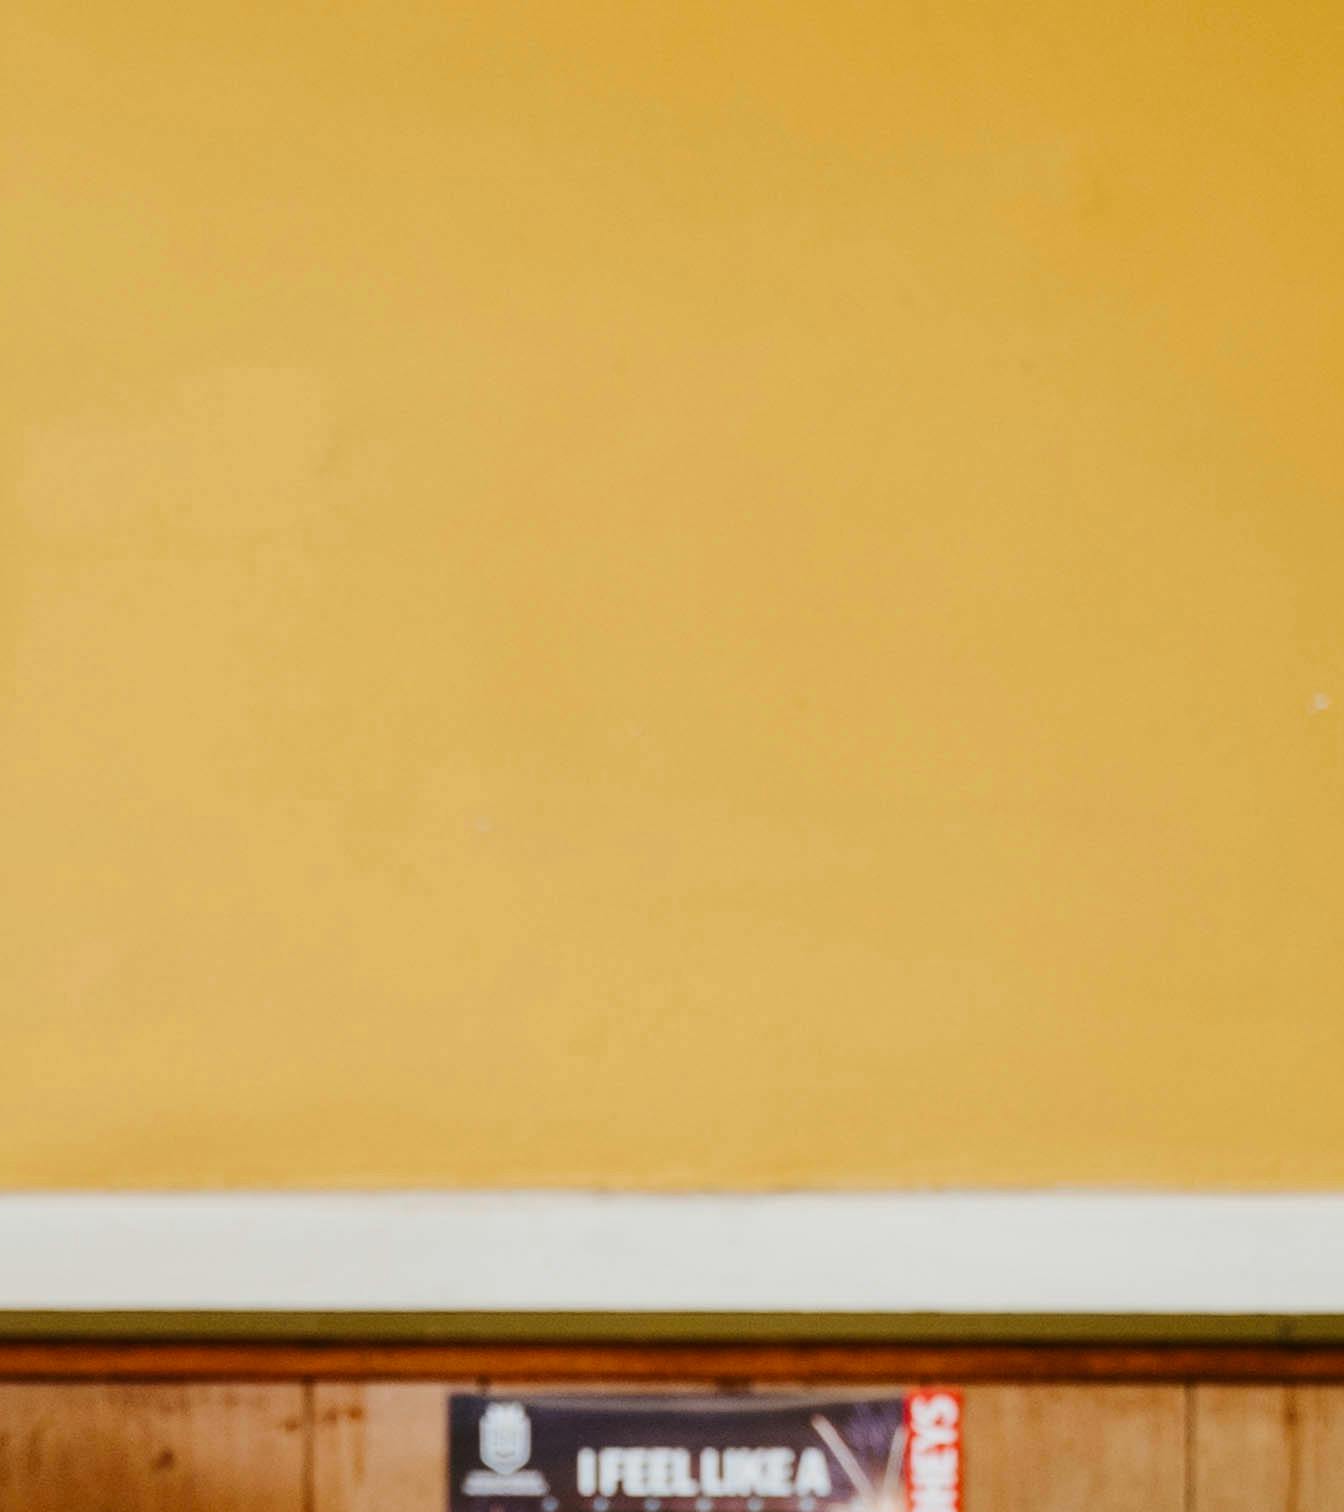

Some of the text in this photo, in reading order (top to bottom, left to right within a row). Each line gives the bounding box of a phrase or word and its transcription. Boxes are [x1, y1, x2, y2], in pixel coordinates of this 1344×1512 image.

[576, 1446, 596, 1498] I
[599, 1446, 697, 1498] FEEL
[700, 1446, 796, 1498] LIKE
[796, 1446, 832, 1498] A
